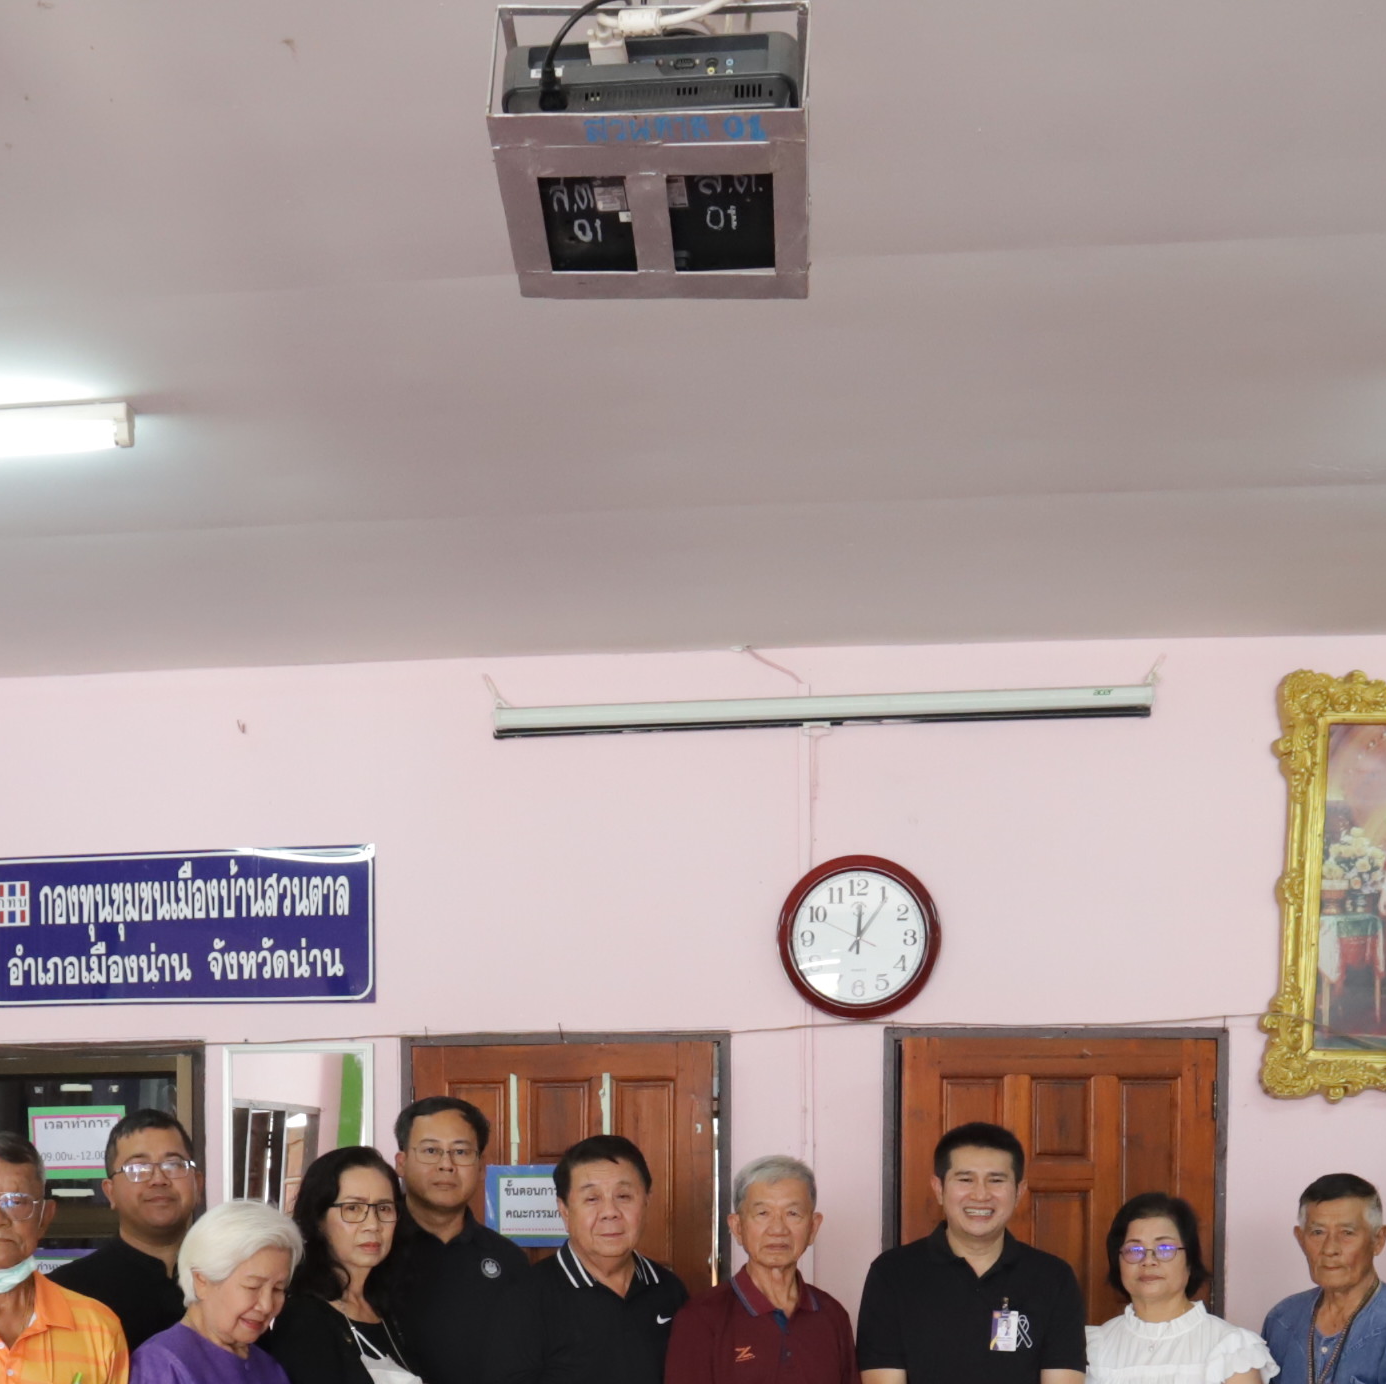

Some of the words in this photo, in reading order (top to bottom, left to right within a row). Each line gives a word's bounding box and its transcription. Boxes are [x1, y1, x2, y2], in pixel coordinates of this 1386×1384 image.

[706, 206, 737, 230] 01
[574, 219, 602, 242] 01
[828, 887, 844, 904] 11
[849, 879, 869, 896] 12
[881, 886, 888, 903] 1
[39, 860, 350, 941] กองทุนชุมชนเมืองบ้านสวนตาล
[809, 906, 827, 922] 10
[897, 904, 909, 921] 2
[800, 930, 815, 947] 9
[903, 929, 917, 946] 3
[8, 942, 191, 986] อำเภอเมืองน่าน
[207, 938, 344, 981] จังหวัดน่าน
[893, 954, 907, 972] 4
[851, 980, 865, 997] 6
[875, 974, 890, 991] 5
[44, 1118, 111, 1130] เวลาทำการ
[506, 1209, 561, 1219] คณะกรรมก
